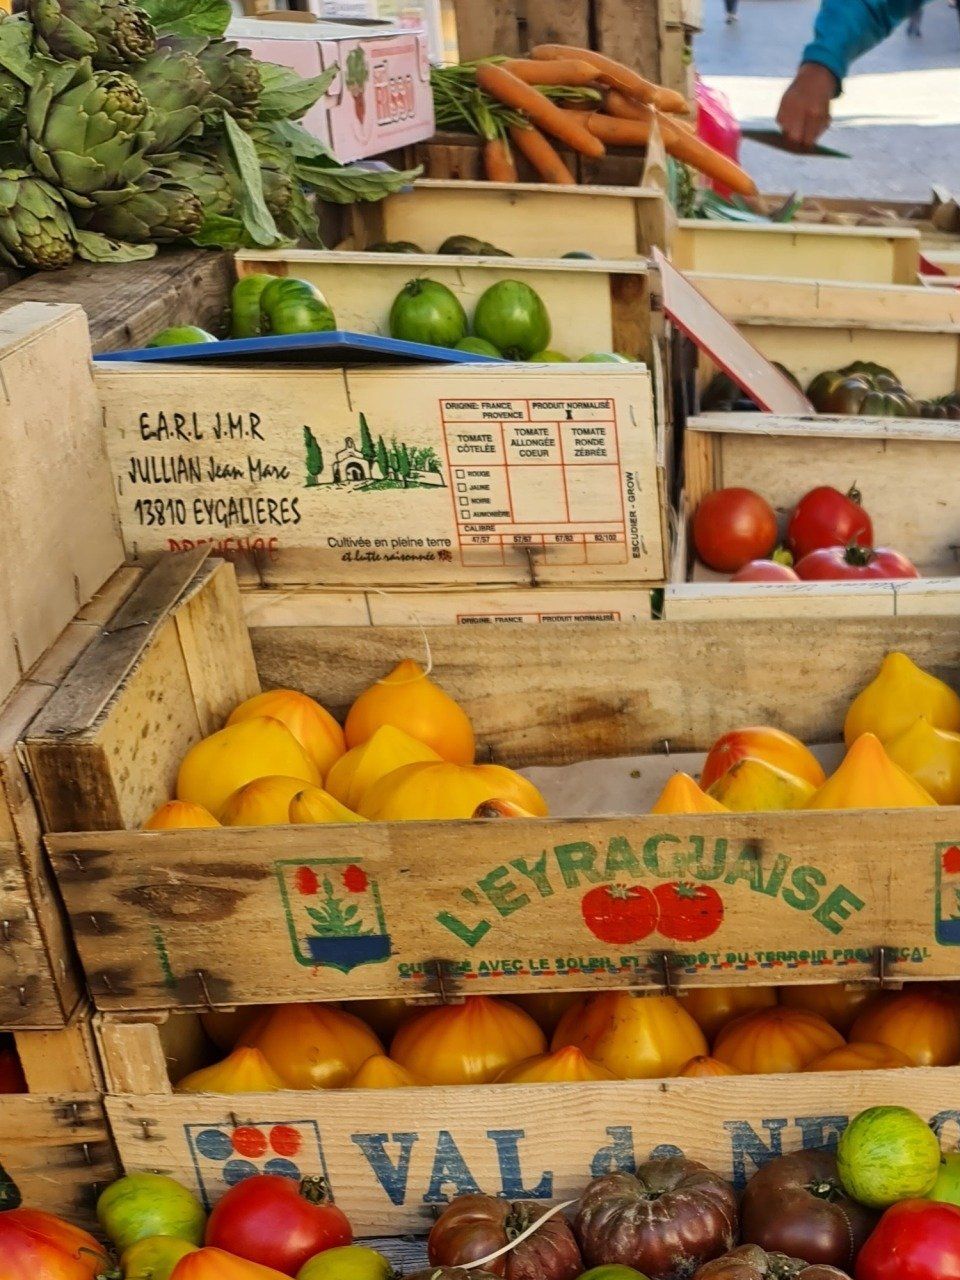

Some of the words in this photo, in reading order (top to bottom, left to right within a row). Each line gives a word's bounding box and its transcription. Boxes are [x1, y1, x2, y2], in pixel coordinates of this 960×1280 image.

[445, 402, 480, 410] ORIGINE:
[481, 402, 512, 410] FRANCE
[532, 402, 565, 410] PRODUIT
[566, 400, 610, 410] NORMALISÉ
[482, 411, 524, 419] PROVENCE
[213, 411, 265, 442] J.M.R
[514, 427, 549, 436] TOMATE
[571, 427, 606, 436] TOMATE
[457, 434, 493, 443] TOMATE
[510, 436, 555, 447] ALLONGÉE
[574, 438, 605, 447] RONDE
[457, 443, 496, 453] CÔTELÉE
[519, 449, 549, 458] COEUR
[128, 455, 201, 484] JULLIAN
[207, 456, 244, 482] Jean
[247, 455, 291, 483] Marc
[467, 470, 490, 478] ROUGE
[469, 483, 490, 491] JAUNE
[626, 472, 637, 503] GROW
[134, 498, 187, 526] 13810
[193, 496, 301, 528] EYGALIERES
[464, 524, 496, 532] CALIBRE
[628, 511, 640, 559] ESCUDIER
[327, 536, 372, 548] Cultivée
[374, 539, 388, 548] en
[391, 537, 423, 550] pleine
[426, 537, 452, 548] terre
[342, 550, 352, 562] et
[354, 550, 382, 562] lutte
[494, 616, 523, 624] FRANCE
[542, 614, 572, 623] PRODUIT
[478, 960, 523, 972] AVEC
[529, 958, 549, 970] LE
[555, 956, 618, 970] SOLEIL
[726, 952, 750, 964] DU
[351, 1128, 553, 1207] VAL
[589, 1125, 684, 1178] d
